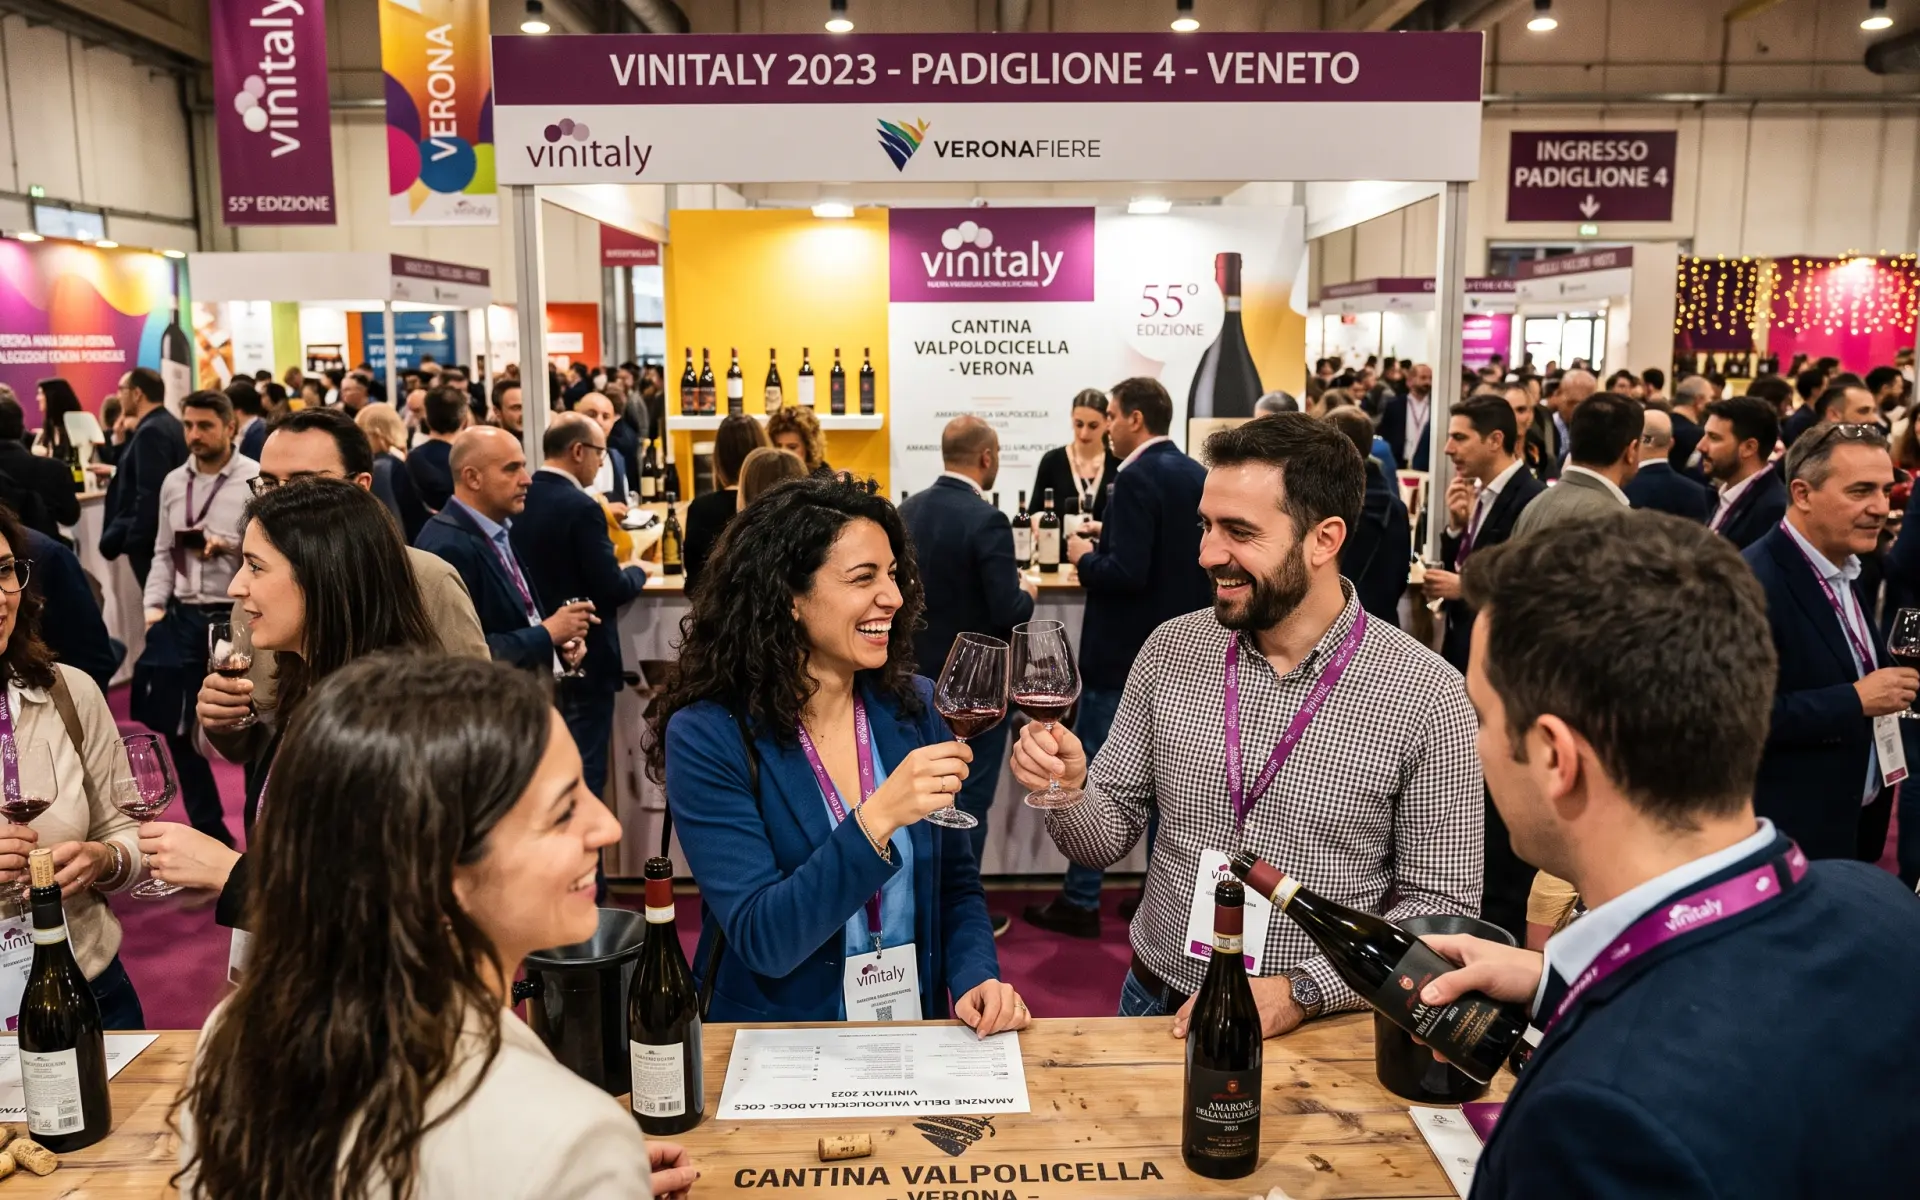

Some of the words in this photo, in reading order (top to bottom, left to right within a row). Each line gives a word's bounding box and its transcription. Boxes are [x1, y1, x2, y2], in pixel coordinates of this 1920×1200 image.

[249, 0, 305, 158] vinitaly
[609, 53, 777, 86] VINITALY
[787, 53, 876, 86] 2023
[887, 68, 901, 76] -
[911, 52, 1143, 86] PADIGLIONE
[1152, 52, 1176, 85] 4
[1185, 67, 1198, 75] -
[1207, 51, 1360, 85] VENETO
[426, 23, 458, 162] VERONA
[526, 135, 652, 176] vinitaly
[934, 139, 1101, 158] VERONAFIERE
[1537, 140, 1648, 162] INGRESSO
[1515, 166, 1643, 188] PADIGLIONE
[1651, 167, 1668, 188] 4
[256, 196, 330, 211] EDIZIONE
[921, 240, 1064, 288] vinitaly
[951, 320, 1032, 333] CANTINA
[1136, 323, 1204, 336] EDIZIONE
[914, 341, 1069, 354] VALPOLDCICELLA
[960, 361, 1034, 375] VERONA
[1664, 899, 1723, 931] vinitaly
[0, 931, 34, 952] vinit
[856, 965, 905, 987] vinitaly
[913, 1099, 950, 1107] DELLA
[1208, 1100, 1254, 1112] AMARONE
[734, 1167, 891, 1188] CANTINA
[901, 1161, 1164, 1185] VALPOLICELLA
[906, 1190, 1017, 1200] VERONA
